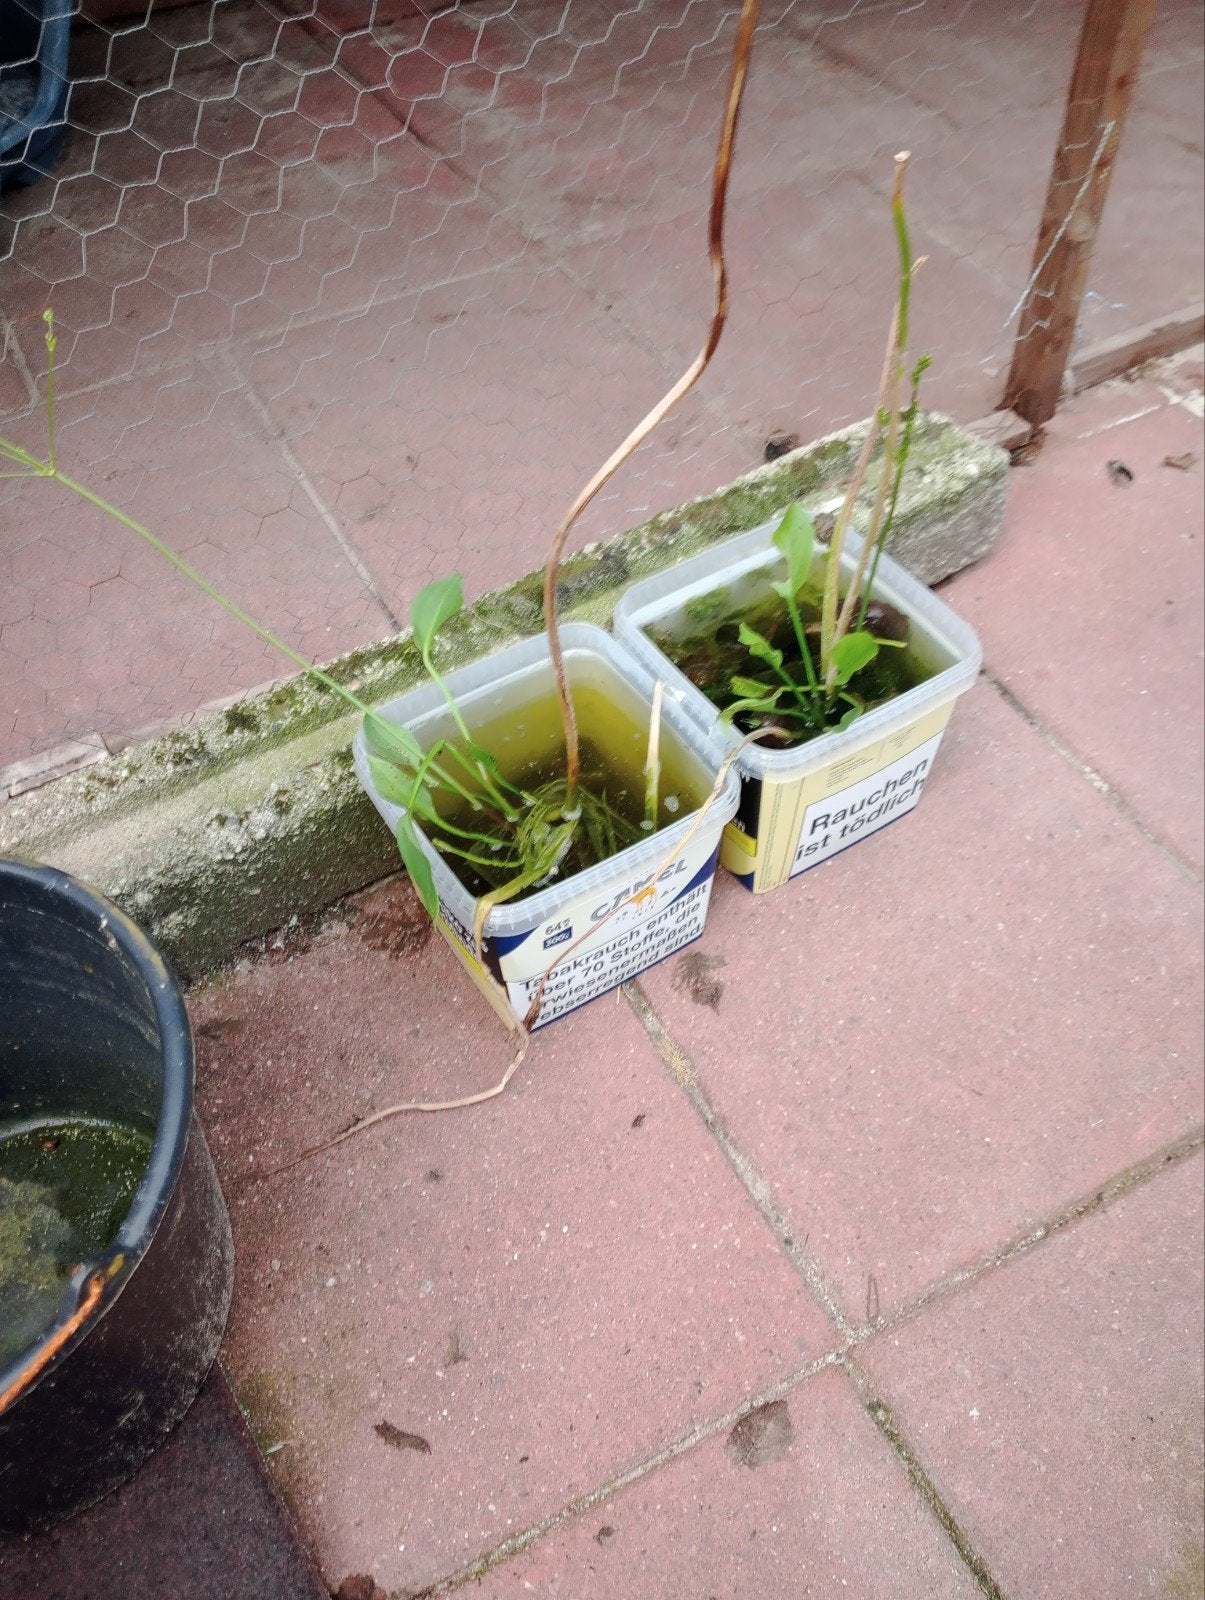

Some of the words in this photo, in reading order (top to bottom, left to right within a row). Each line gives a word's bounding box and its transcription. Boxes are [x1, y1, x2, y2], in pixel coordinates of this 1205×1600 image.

[795, 836, 834, 862] ist
[839, 777, 925, 840] tödlich
[808, 757, 928, 837] Rauchen
[519, 929, 640, 992] Tabakrauch
[646, 882, 709, 931] enthält
[539, 950, 660, 1022] ebserregend
[664, 923, 705, 953] sind.
[541, 915, 698, 1010] rwiesenermaßen
[580, 959, 605, 979] 70
[611, 926, 672, 964] Stoffe,
[675, 900, 701, 927] die
